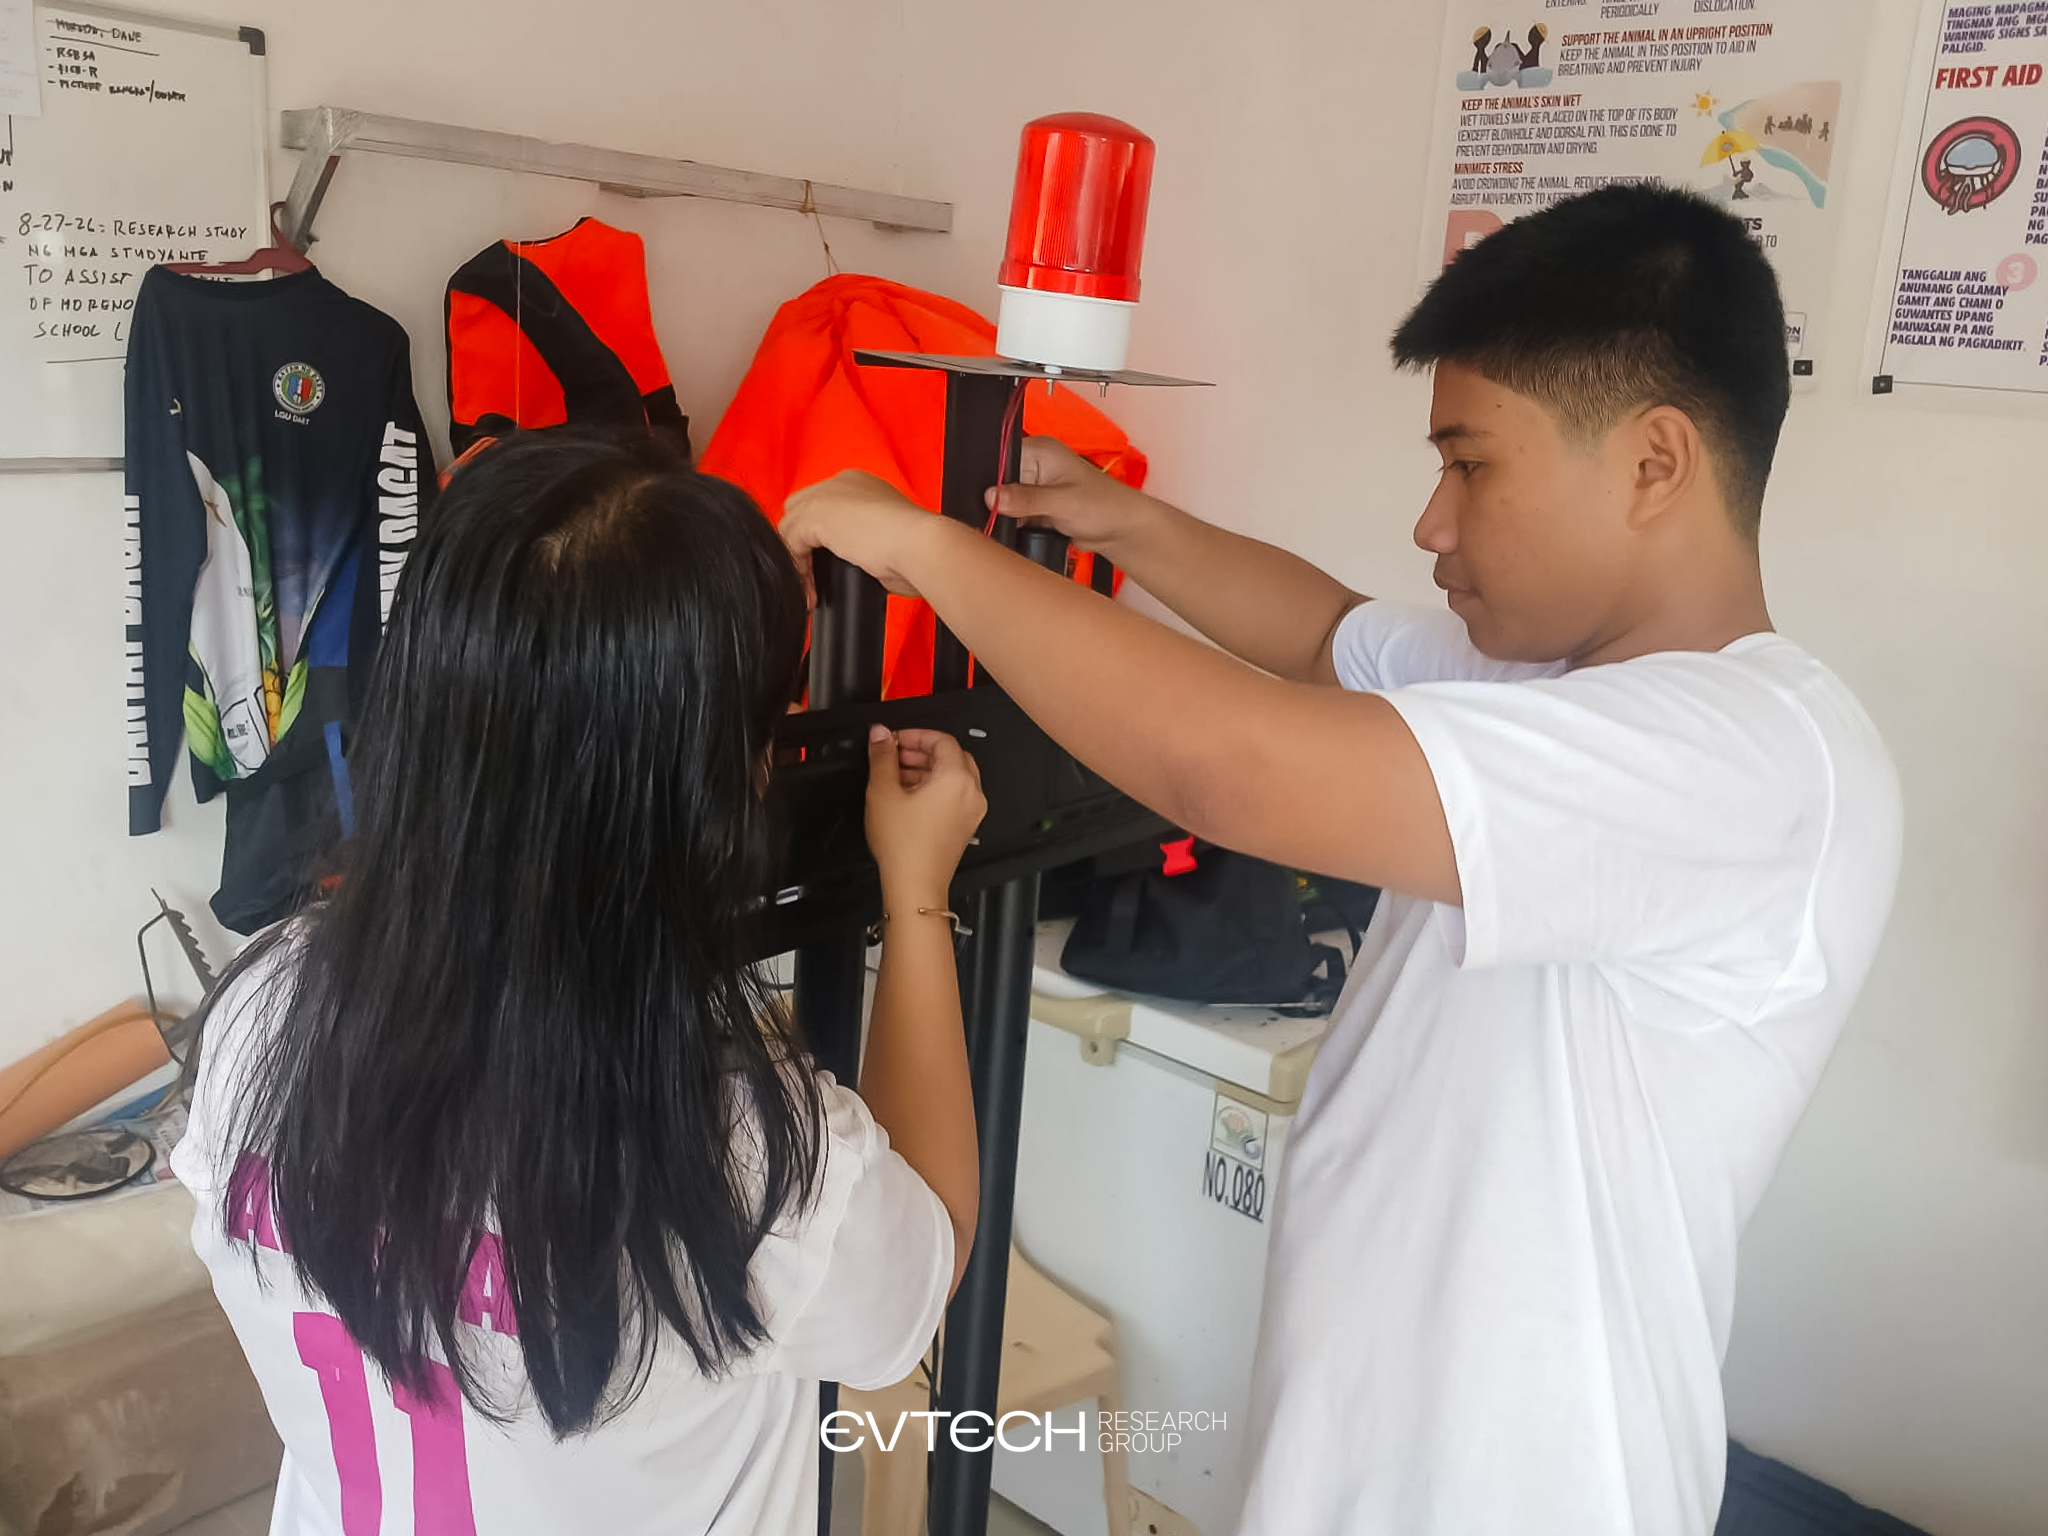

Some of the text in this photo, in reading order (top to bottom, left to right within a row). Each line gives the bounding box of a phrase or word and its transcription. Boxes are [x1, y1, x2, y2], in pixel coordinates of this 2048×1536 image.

[1600, 4, 1659, 18] PERIODICALLY
[1948, 1, 2048, 18] MAGING MAPAGM
[1947, 18, 1994, 30] TINGNAN
[1996, 15, 2019, 27] ANG
[1562, 23, 1773, 46] SUPPORT THE ANIMAL IN AN UPRIGHT POSITION
[1944, 25, 2047, 42] WARNING SIGNS SA
[1560, 40, 1757, 61] KEEP THE ANIMAL IN THIS POSITION TO AID IN
[1941, 41, 1986, 54] PALIGID.
[1558, 58, 1702, 77] BREATHING AND PREVENT INJURY
[1935, 63, 2043, 89] FIRST AID
[1461, 94, 1582, 110] KEEP THE ANIMAL'S SKIN WET
[1460, 107, 1678, 127] WET TOWELS MAY BE PLACED ON THE TOP OF ITS BODY
[1491, 127, 1535, 141] BLOWHOLE
[1536, 127, 1553, 139] AND
[1554, 126, 1586, 139] DORSAL
[1609, 124, 1629, 137] THIS
[1630, 124, 1638, 137] IS
[1640, 124, 1664, 137] DONE
[1665, 123, 1677, 136] TO
[1456, 144, 1490, 157] PREVENT
[1492, 143, 1545, 156] DEHYDRATION
[1547, 142, 1565, 155] AND
[1454, 161, 1523, 175] MINIMIZE STRESS
[1451, 178, 1475, 190] AVOID
[1477, 177, 1519, 190] CROWDING
[1521, 177, 1536, 189] THE
[1482, 192, 1533, 205] MOVEMENTS
[1535, 192, 1545, 204] TO
[114, 220, 197, 239] RESEARCH
[205, 226, 247, 239] STUDY
[2028, 219, 2044, 230] NG
[64, 245, 98, 258] MGA
[110, 247, 209, 262] STUDYANTE
[23, 264, 134, 286] TO ASSIST
[1902, 269, 1986, 282] TANGGALIN ANG
[2006, 262, 2025, 284] 3
[1899, 282, 2009, 297] ANUMANG GALAMAY
[29, 297, 134, 312] OF MORENO
[1897, 295, 2004, 310] GAMIT ANG CHANI O
[1895, 308, 1993, 323] GUWANTES UPANG
[33, 321, 101, 339] SCHOOL
[1892, 321, 1994, 336] MAIWASAN PA ANG
[1890, 334, 1936, 346] PAGLALA
[1939, 336, 1954, 347] NG
